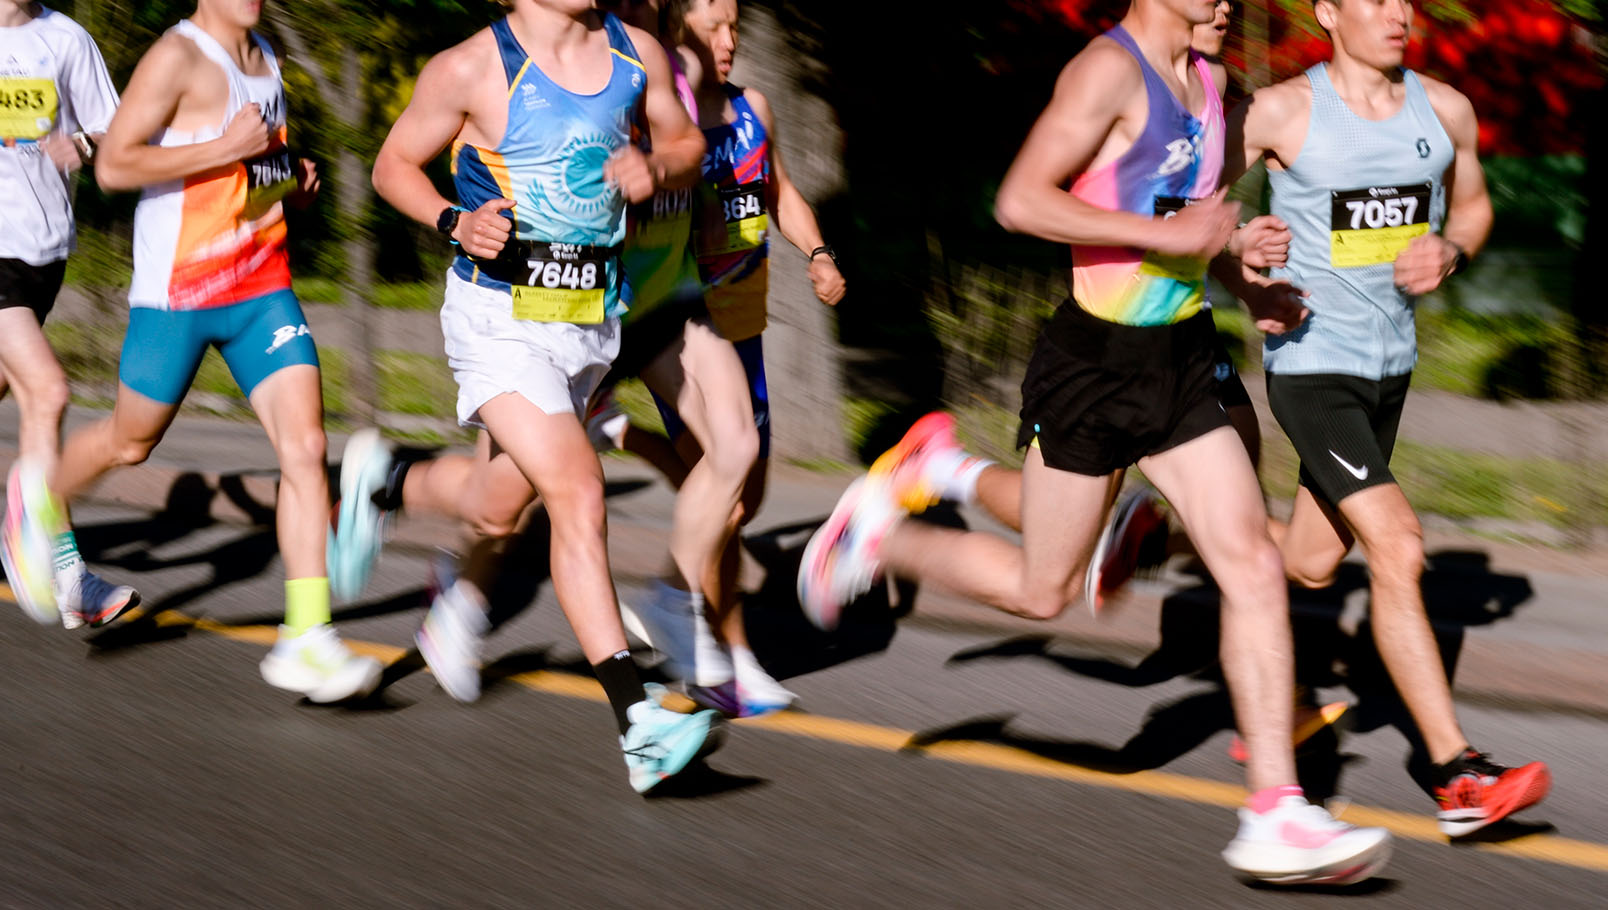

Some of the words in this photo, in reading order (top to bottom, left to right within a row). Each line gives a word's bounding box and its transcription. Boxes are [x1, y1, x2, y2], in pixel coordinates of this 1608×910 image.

[1345, 196, 1419, 230] 7057
[527, 260, 597, 290] 7648
[514, 287, 522, 300] A
